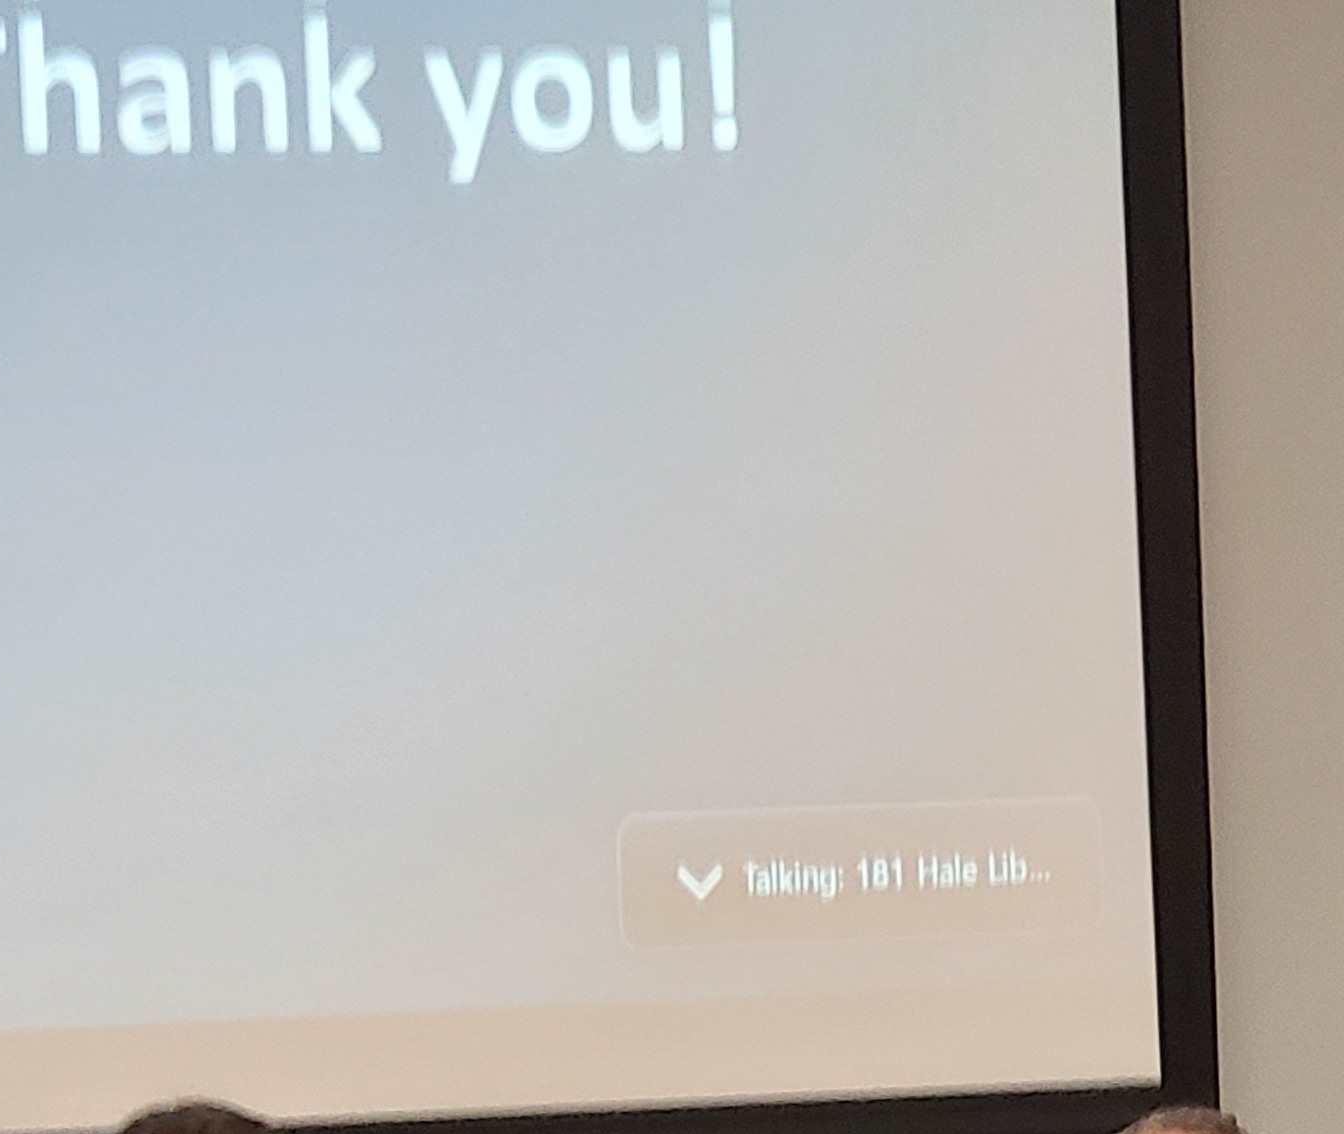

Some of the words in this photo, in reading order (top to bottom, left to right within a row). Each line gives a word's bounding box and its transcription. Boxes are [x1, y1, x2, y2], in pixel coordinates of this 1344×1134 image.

[424, 2, 739, 184] you!
[743, 857, 844, 902] Talking:
[857, 855, 903, 890] 181
[918, 852, 978, 888] Hale
[987, 848, 1051, 885] Lib...
